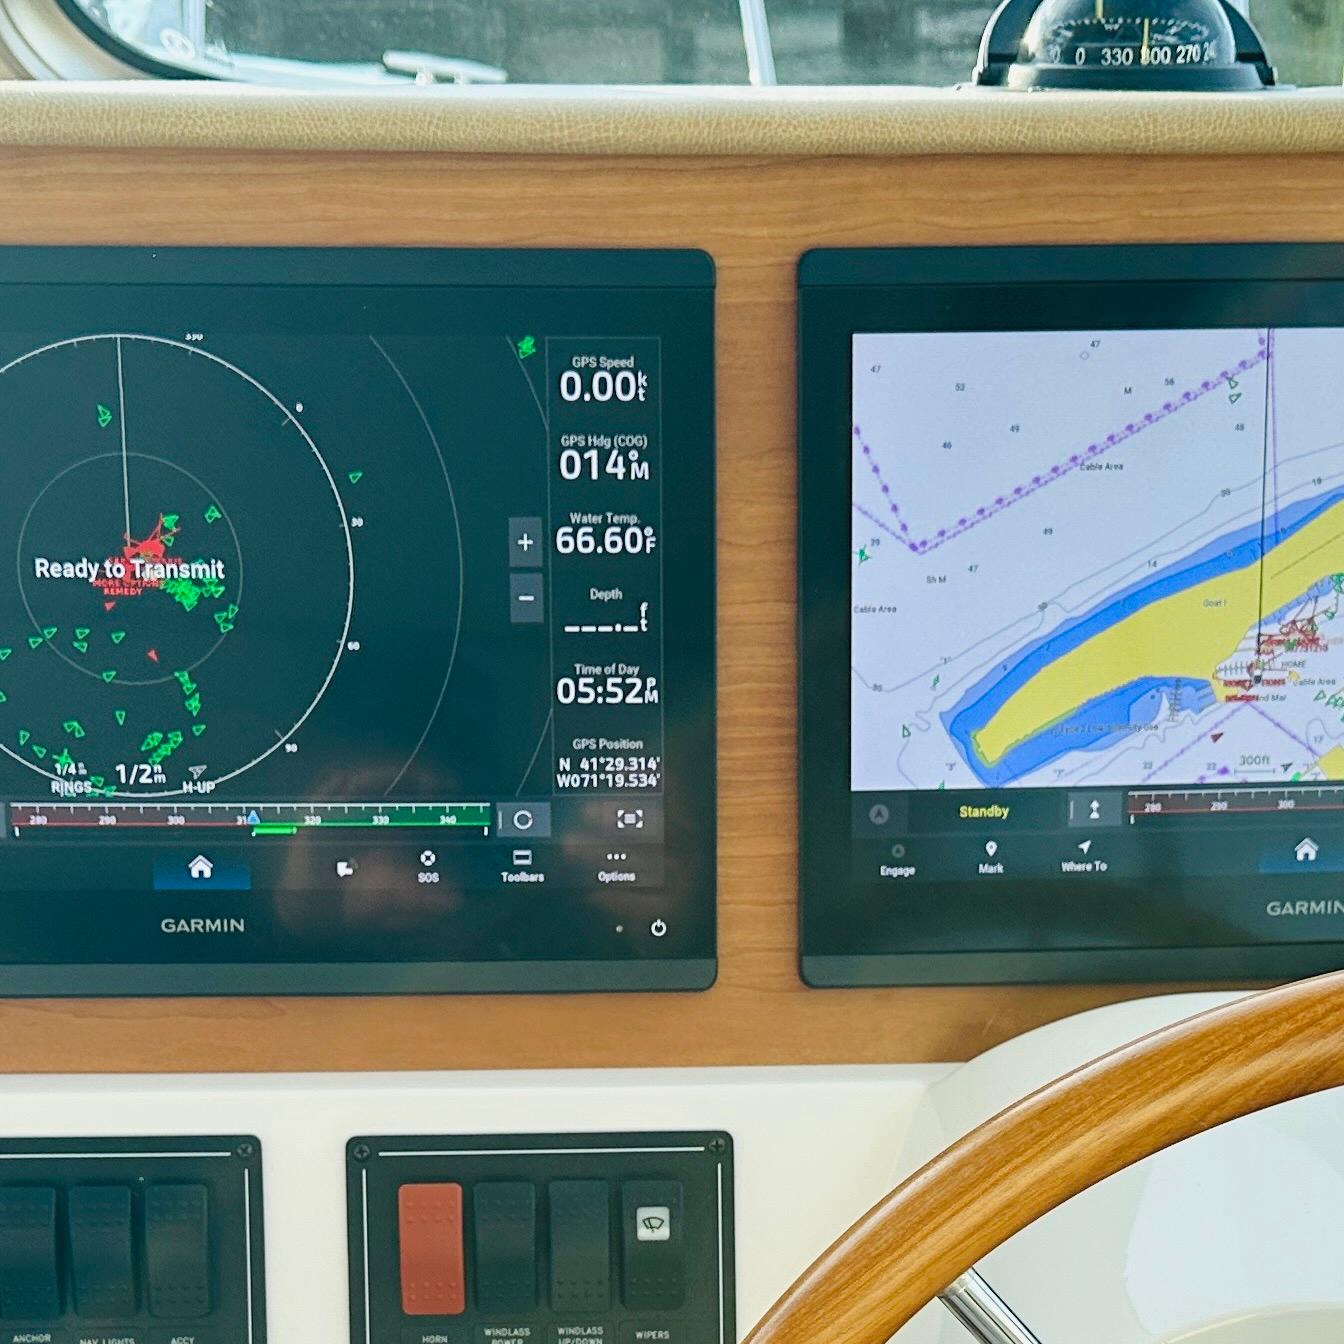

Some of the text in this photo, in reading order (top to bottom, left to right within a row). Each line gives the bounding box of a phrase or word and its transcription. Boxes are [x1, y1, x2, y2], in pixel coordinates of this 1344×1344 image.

[1101, 47, 1133, 66] 330
[1177, 44, 1200, 64] 270
[572, 356, 634, 370] GPS Speed
[559, 371, 637, 402] 0.00
[561, 433, 648, 451] GPS Hdg (COG)
[559, 450, 626, 481] 014
[569, 512, 641, 527] Water Temp.
[556, 527, 644, 554] 66.60
[34, 558, 225, 582] Ready to Transmit
[590, 587, 623, 603] Depth
[574, 663, 640, 679] Time of Day
[556, 678, 644, 704] 05:52
[573, 738, 644, 751] GPS Position
[559, 757, 571, 771] N
[115, 763, 154, 785] 1/2
[51, 780, 92, 794] RINGS
[182, 780, 216, 794] H-UP
[959, 805, 1010, 819] Standby
[880, 865, 916, 877] Engage
[978, 863, 1004, 875] Mark
[1061, 860, 1108, 873] Where To
[417, 871, 440, 884] SOS
[501, 871, 545, 884] Toolbars
[597, 871, 636, 885] Options
[160, 917, 246, 934] GARMIN
[484, 1327, 531, 1337] WINDLASS
[557, 1326, 604, 1336] WINDLASS
[635, 1330, 670, 1340] WIPERS
[12, 1334, 52, 1344] ANCHOR
[422, 1334, 448, 1344] HORN
